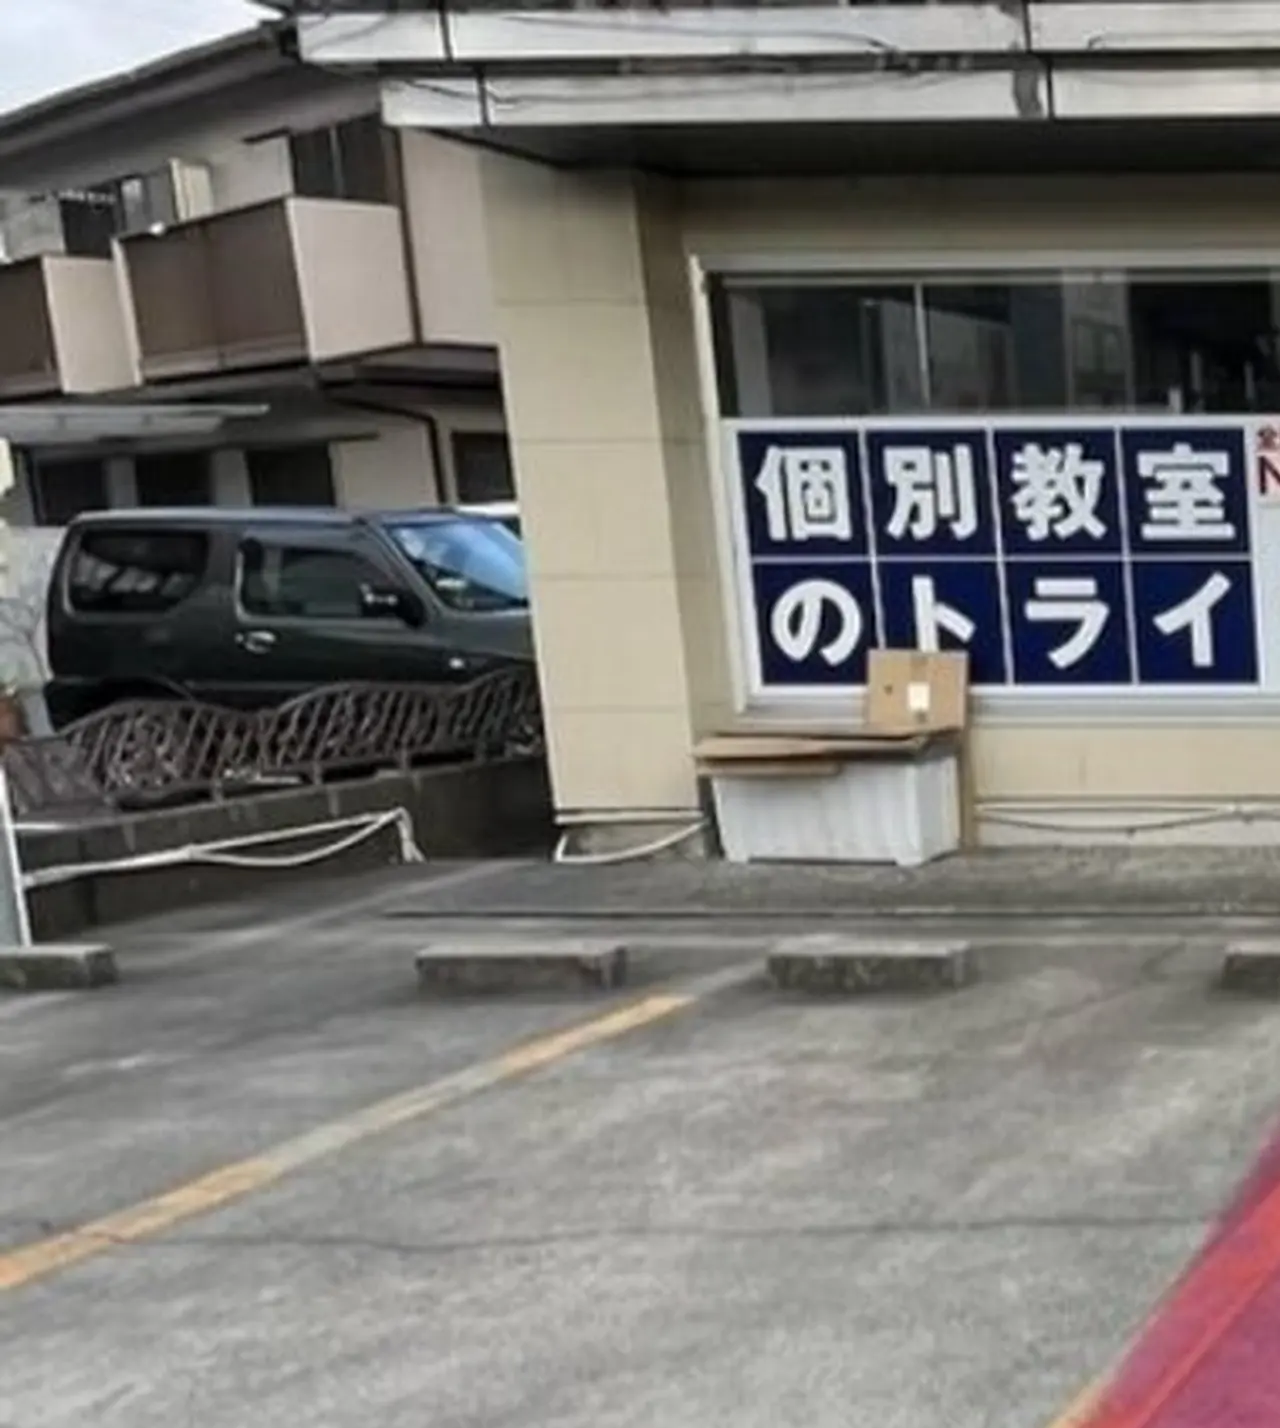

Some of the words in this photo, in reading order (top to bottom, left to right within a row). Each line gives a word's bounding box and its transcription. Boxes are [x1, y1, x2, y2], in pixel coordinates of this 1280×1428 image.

[754, 442, 1236, 541] 個別教室
[770, 570, 1232, 669] のトライ
